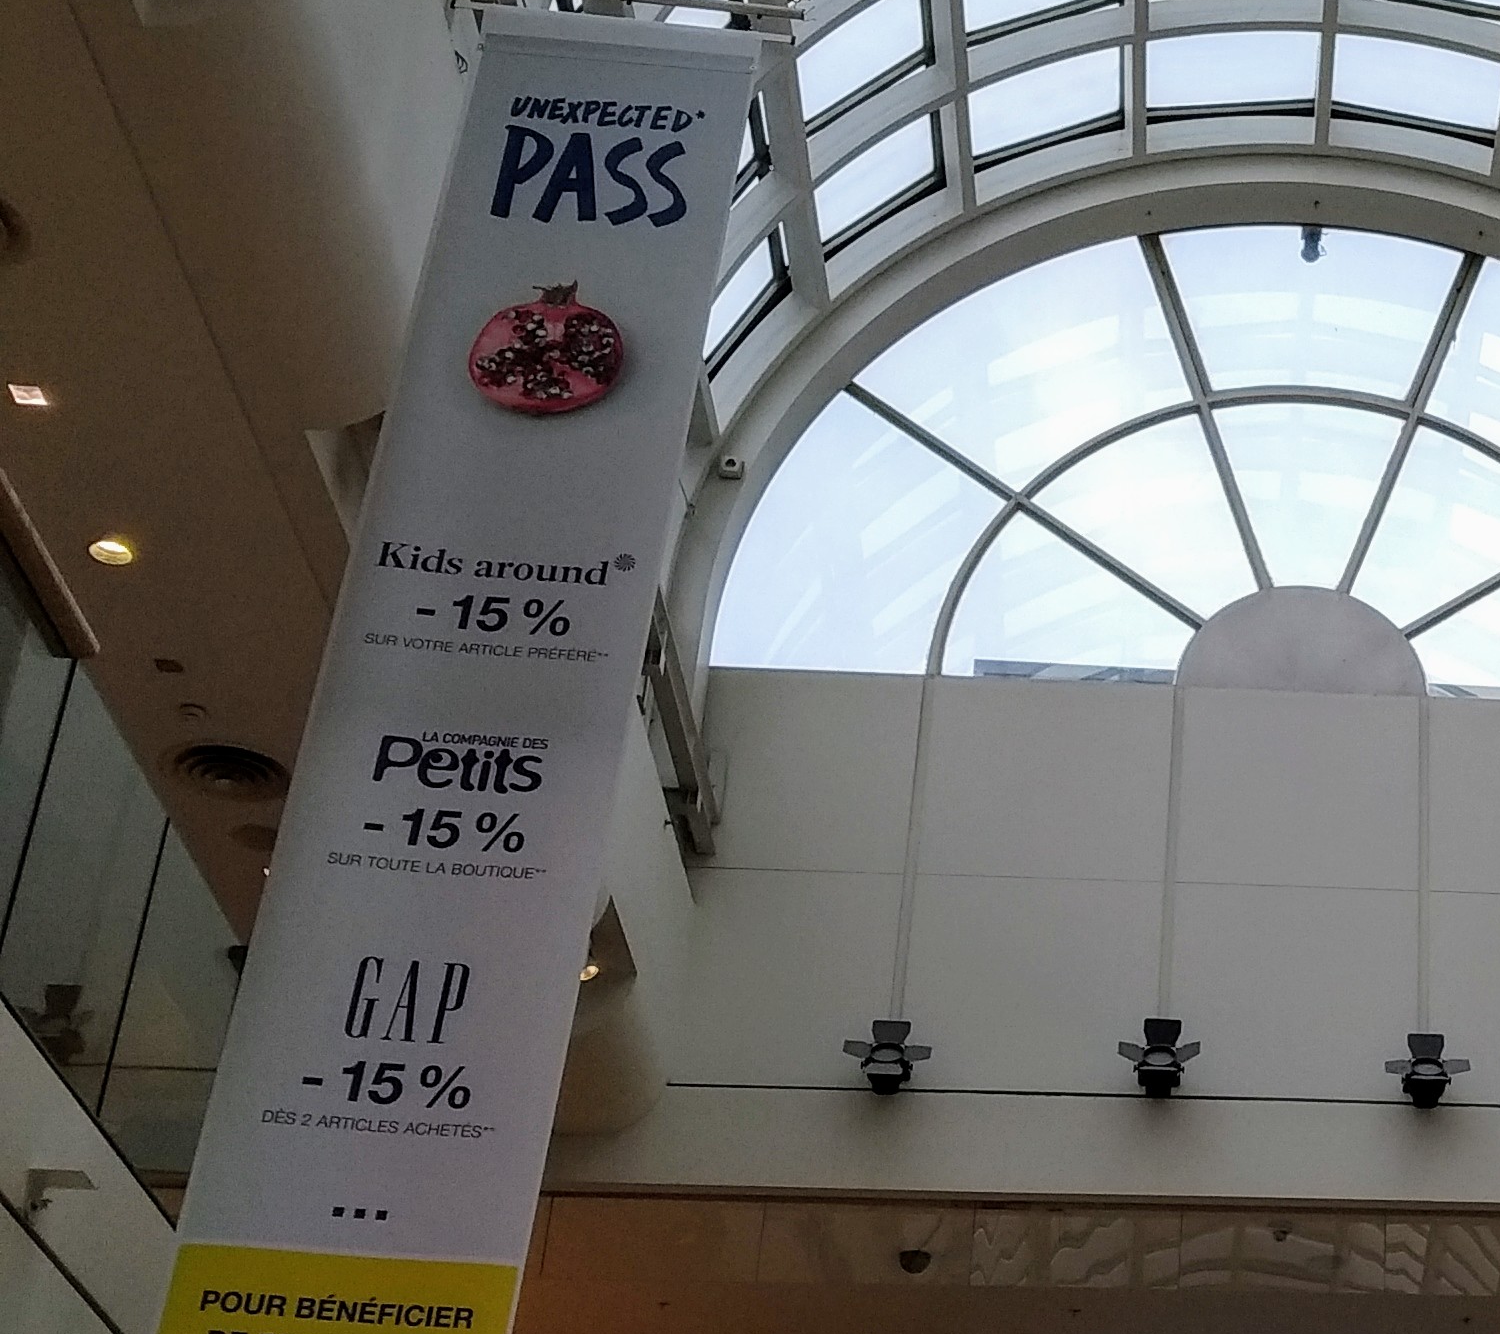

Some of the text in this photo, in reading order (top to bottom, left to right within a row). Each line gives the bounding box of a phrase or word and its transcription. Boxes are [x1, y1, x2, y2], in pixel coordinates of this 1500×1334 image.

[490, 124, 688, 227] PASS
[376, 540, 609, 586] Kids around
[365, 633, 397, 646] SUR
[403, 637, 454, 653] VOTRE
[459, 642, 523, 658] ARTICLE
[422, 731, 548, 749] LA COMPAGNIE DES
[372, 734, 543, 794] Petits
[327, 852, 361, 866] SUR
[369, 856, 420, 873] TOUTE
[426, 861, 447, 873] LA
[344, 956, 470, 1044] GAP
[262, 1108, 296, 1126] DÈS
[301, 1114, 312, 1127] 2
[316, 1116, 399, 1134] ARTICLES
[199, 1289, 474, 1330] POUR BÉNÉFICIER
